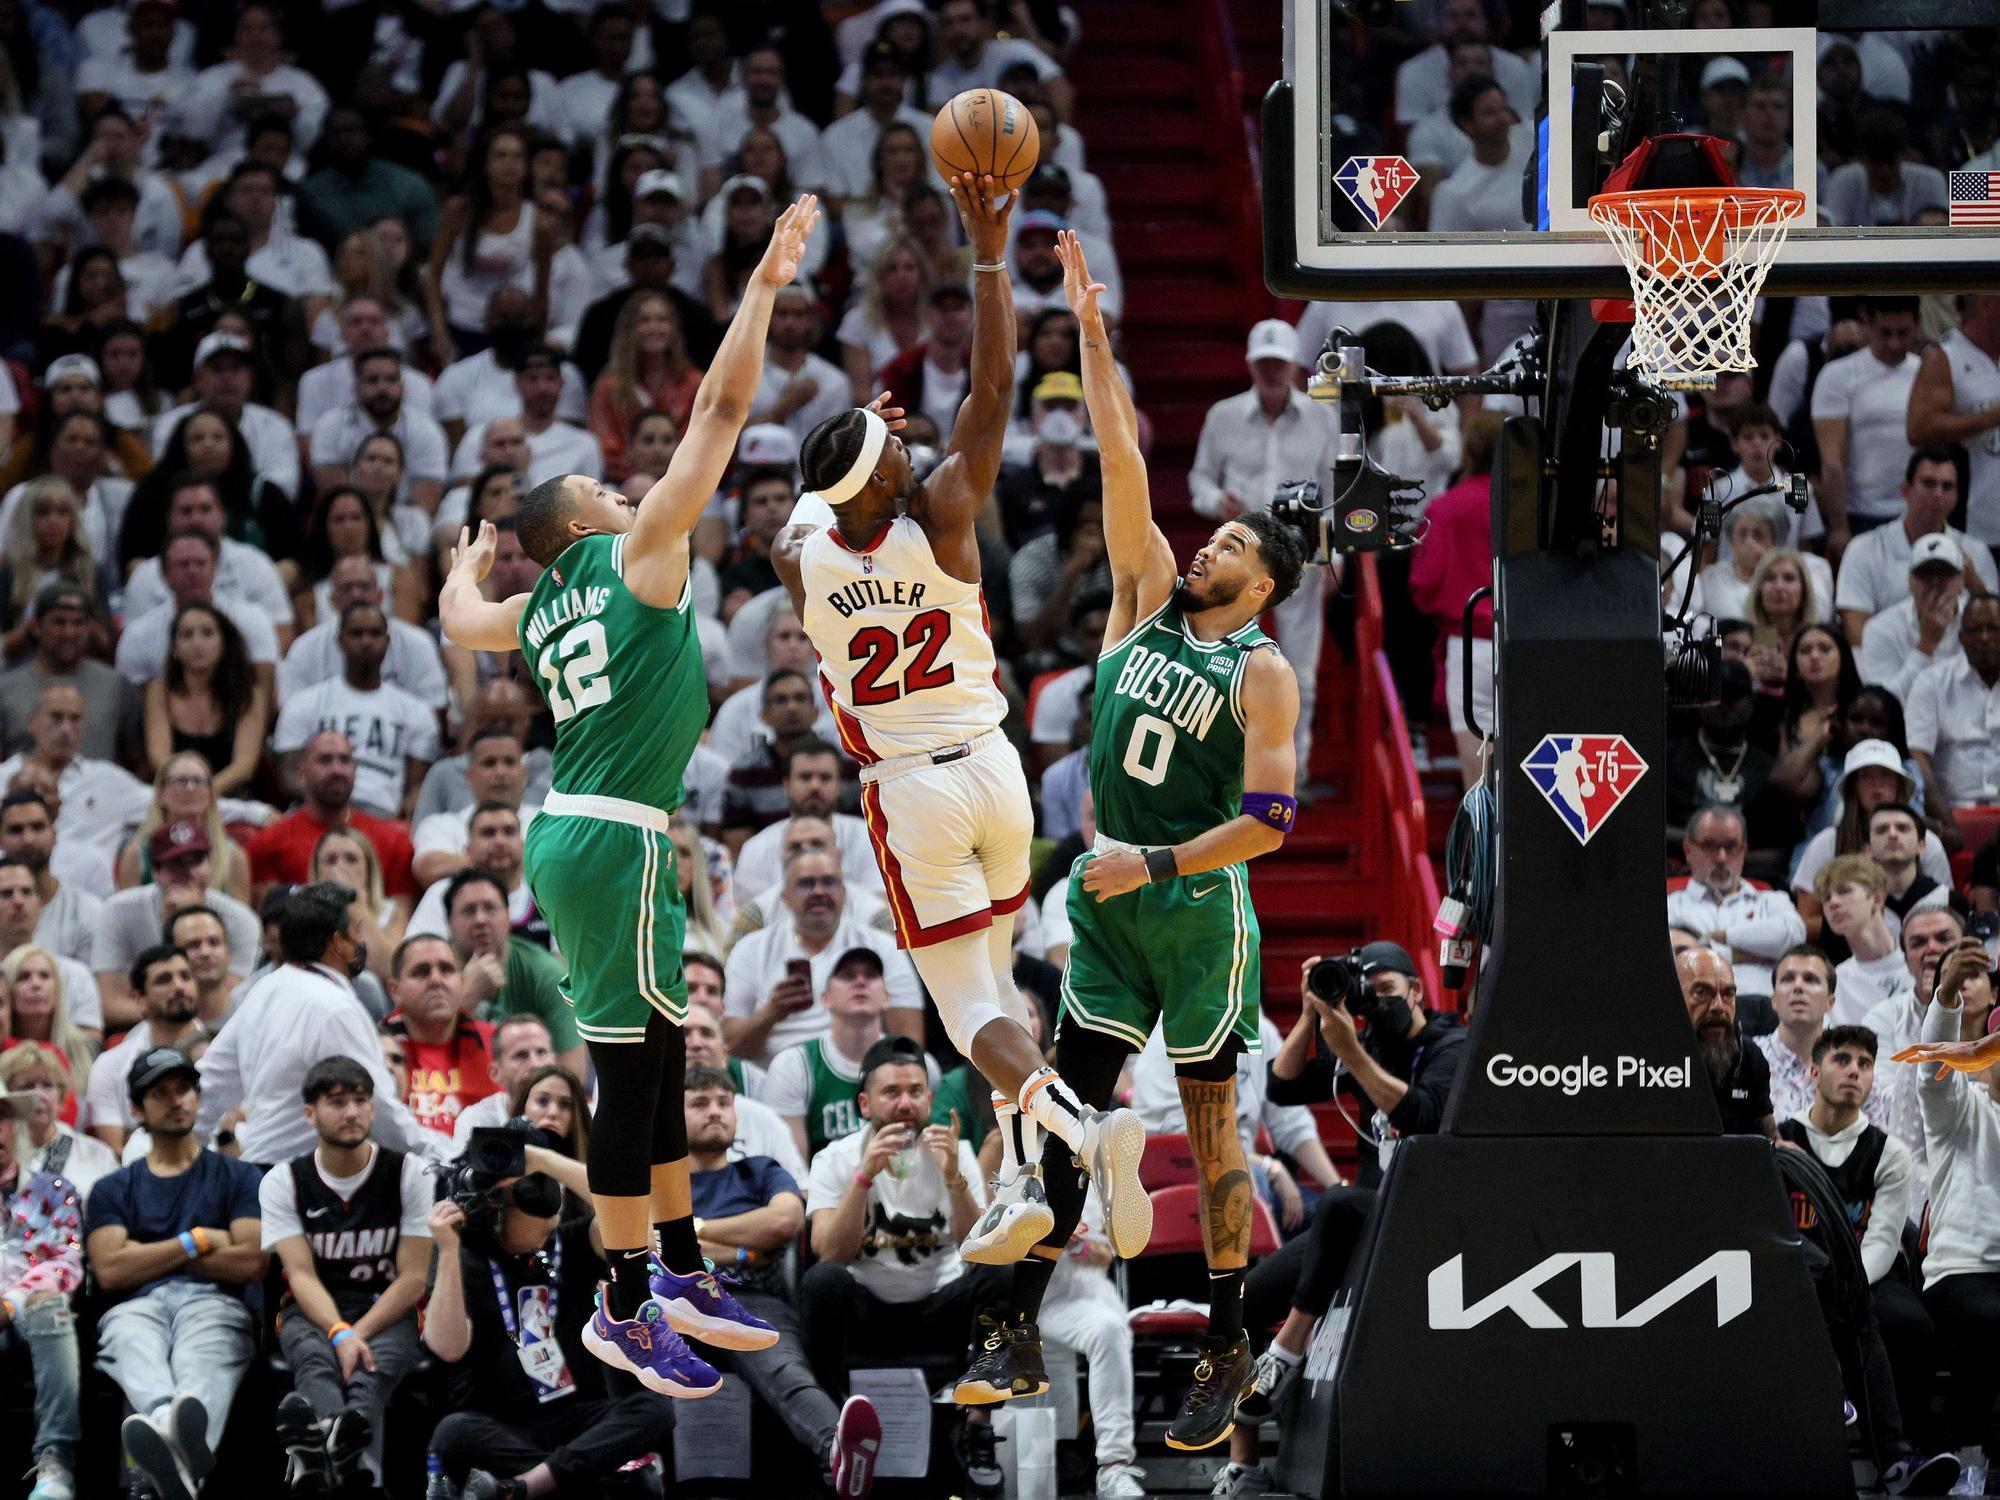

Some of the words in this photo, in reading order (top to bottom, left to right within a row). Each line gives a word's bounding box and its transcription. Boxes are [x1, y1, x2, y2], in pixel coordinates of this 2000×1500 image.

[1384, 167, 1400, 189] 75
[525, 586, 610, 650] WILLIAMS
[827, 580, 926, 618] BUTLER
[538, 619, 611, 723] 12
[848, 608, 955, 706] 22
[1206, 663, 1232, 676] PRINT
[1210, 655, 1235, 669] VISTA
[1114, 645, 1225, 742] BOSTON
[1122, 713, 1177, 787] 0
[1595, 751, 1619, 783] 75
[1268, 802, 1292, 823] 24
[1486, 1054, 1608, 1096] Google
[1617, 1056, 1691, 1088] Pixel
[822, 1099, 866, 1139] CEL
[305, 1226, 397, 1260] MIAMI
[1427, 1250, 1752, 1330] KIA
